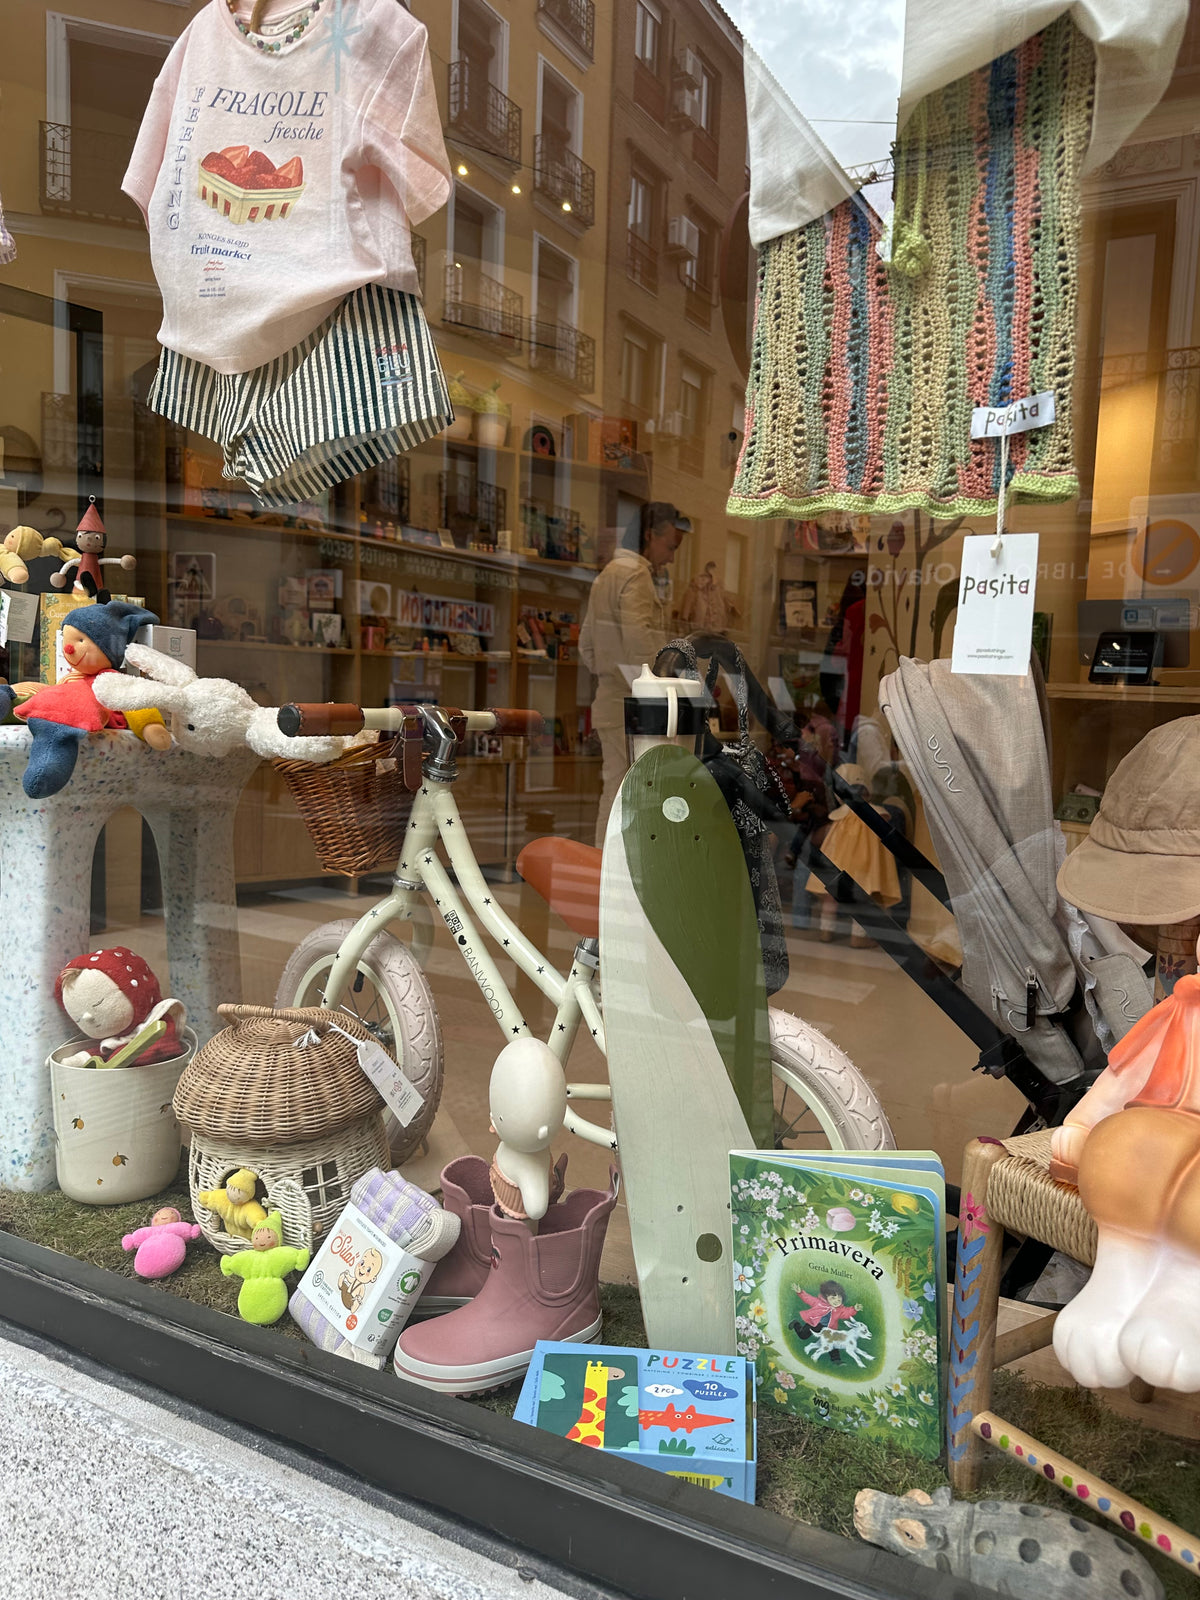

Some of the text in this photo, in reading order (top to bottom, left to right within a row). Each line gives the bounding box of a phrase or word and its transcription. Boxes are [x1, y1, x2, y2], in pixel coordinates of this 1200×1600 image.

[207, 86, 328, 118] FRAGOLE
[264, 120, 324, 143] fresche
[167, 86, 206, 230] FEELING
[191, 244, 252, 260] fruit market
[984, 401, 1040, 434] pasita
[961, 573, 1031, 605] pasita
[463, 947, 504, 1020] BANWOOD
[774, 1231, 886, 1281] Primavera
[808, 1262, 829, 1274] Gerda
[647, 1354, 736, 1374] PUZZLE
[654, 1386, 660, 1394] 2
[694, 1389, 728, 1398] PUZZLES
[703, 1382, 718, 1391] 10
